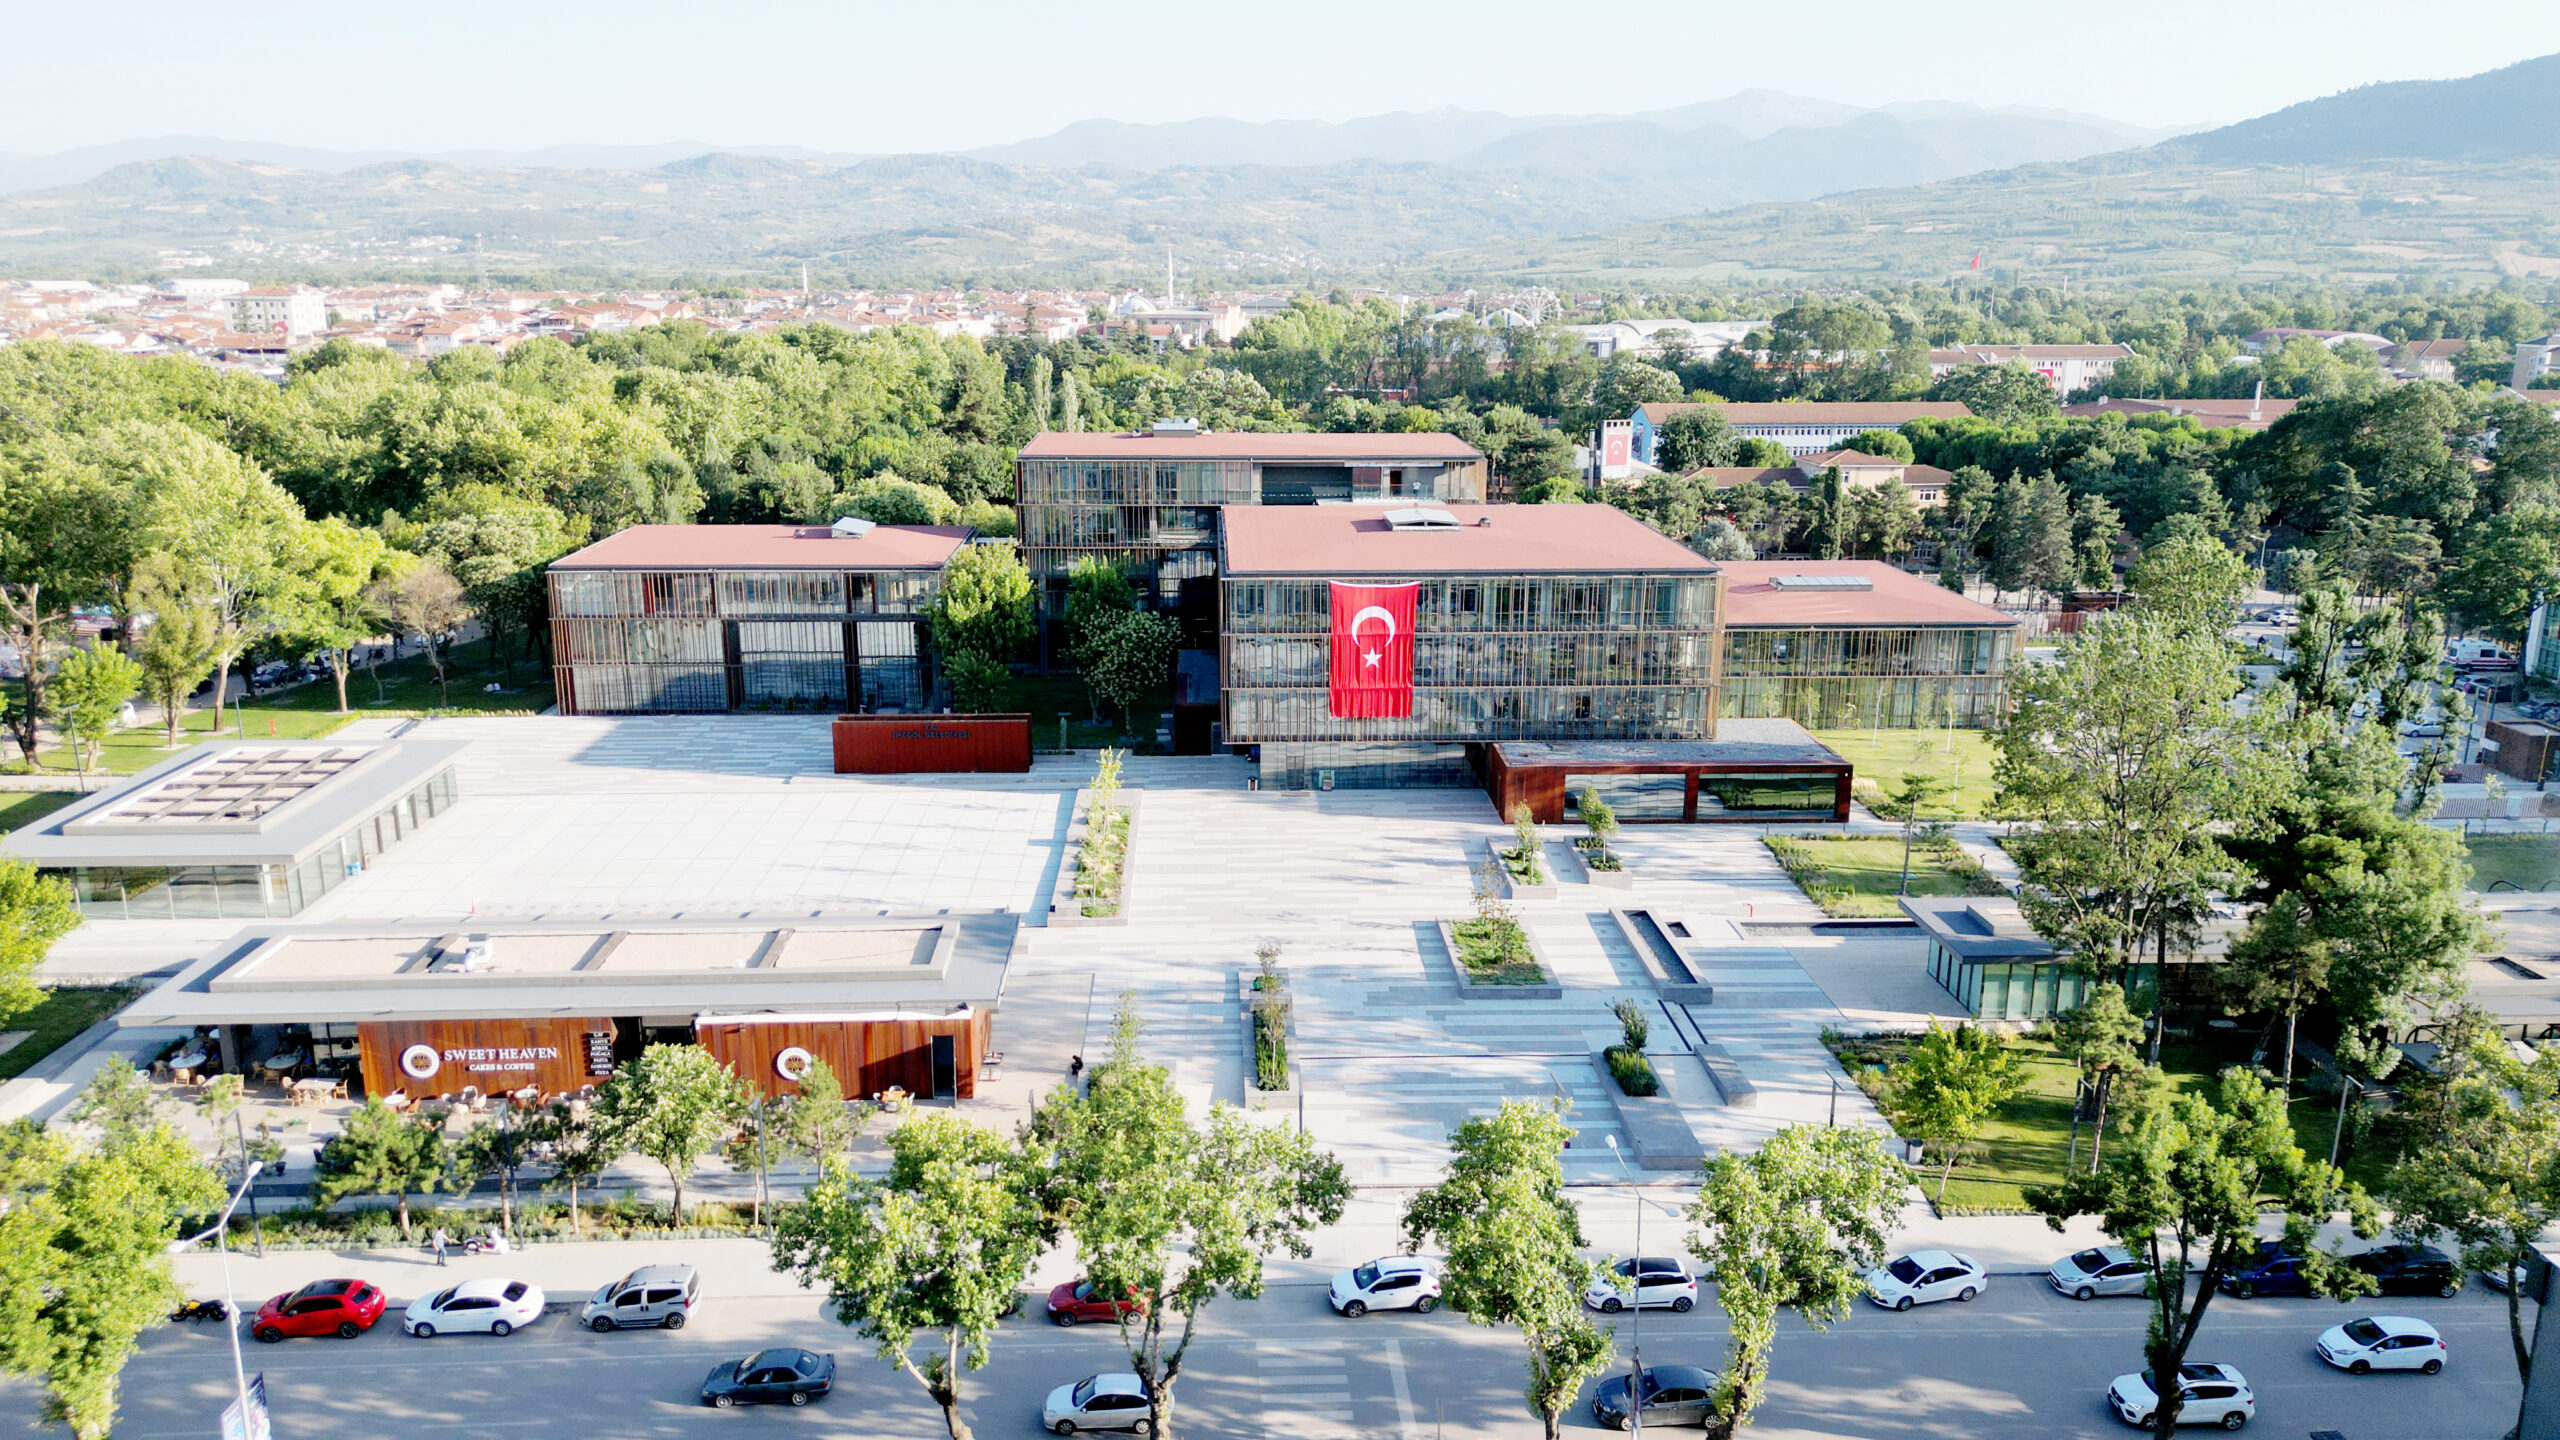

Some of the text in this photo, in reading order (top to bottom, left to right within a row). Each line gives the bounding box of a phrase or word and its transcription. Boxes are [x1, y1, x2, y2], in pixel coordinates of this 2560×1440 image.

[444, 1047, 558, 1061] SWEET HEAVEN
[504, 1063, 536, 1071] COFFEE
